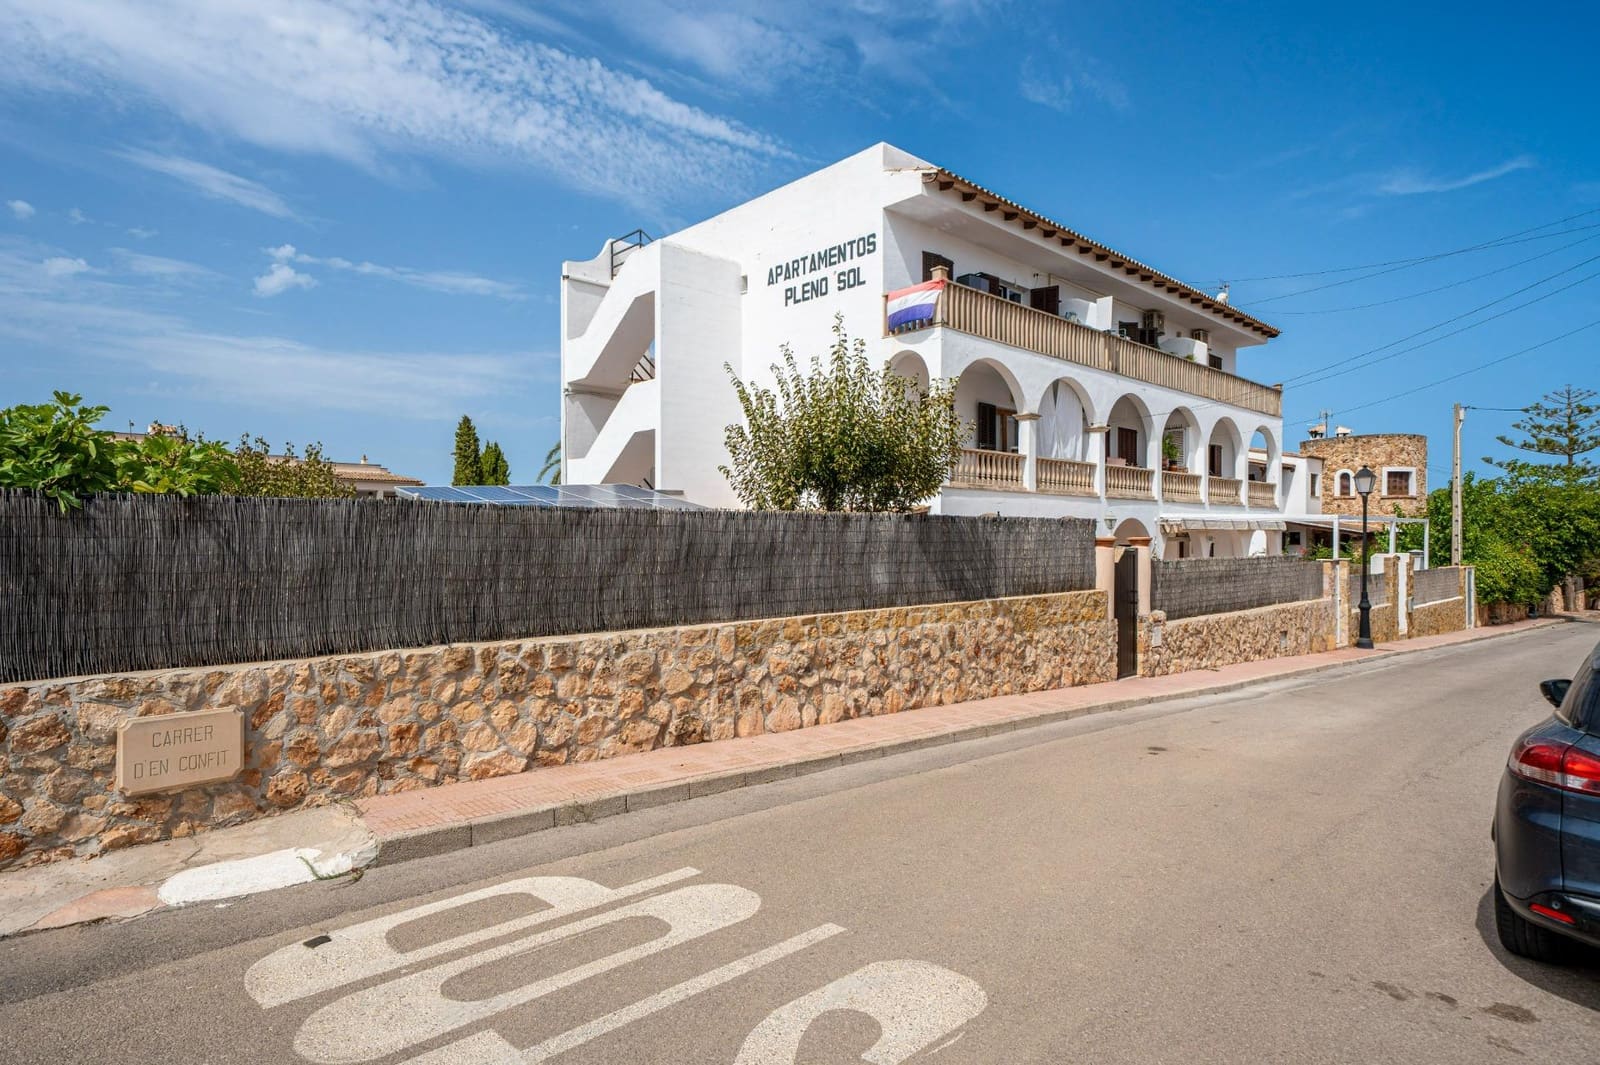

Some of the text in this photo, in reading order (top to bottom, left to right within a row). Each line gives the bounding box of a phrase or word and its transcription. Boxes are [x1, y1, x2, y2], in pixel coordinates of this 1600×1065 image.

[767, 233, 877, 286] APARTAMENTOS
[785, 267, 866, 307] PLENO SOL
[152, 725, 214, 748] CARRER
[134, 750, 230, 780] D'EN CONFIT
